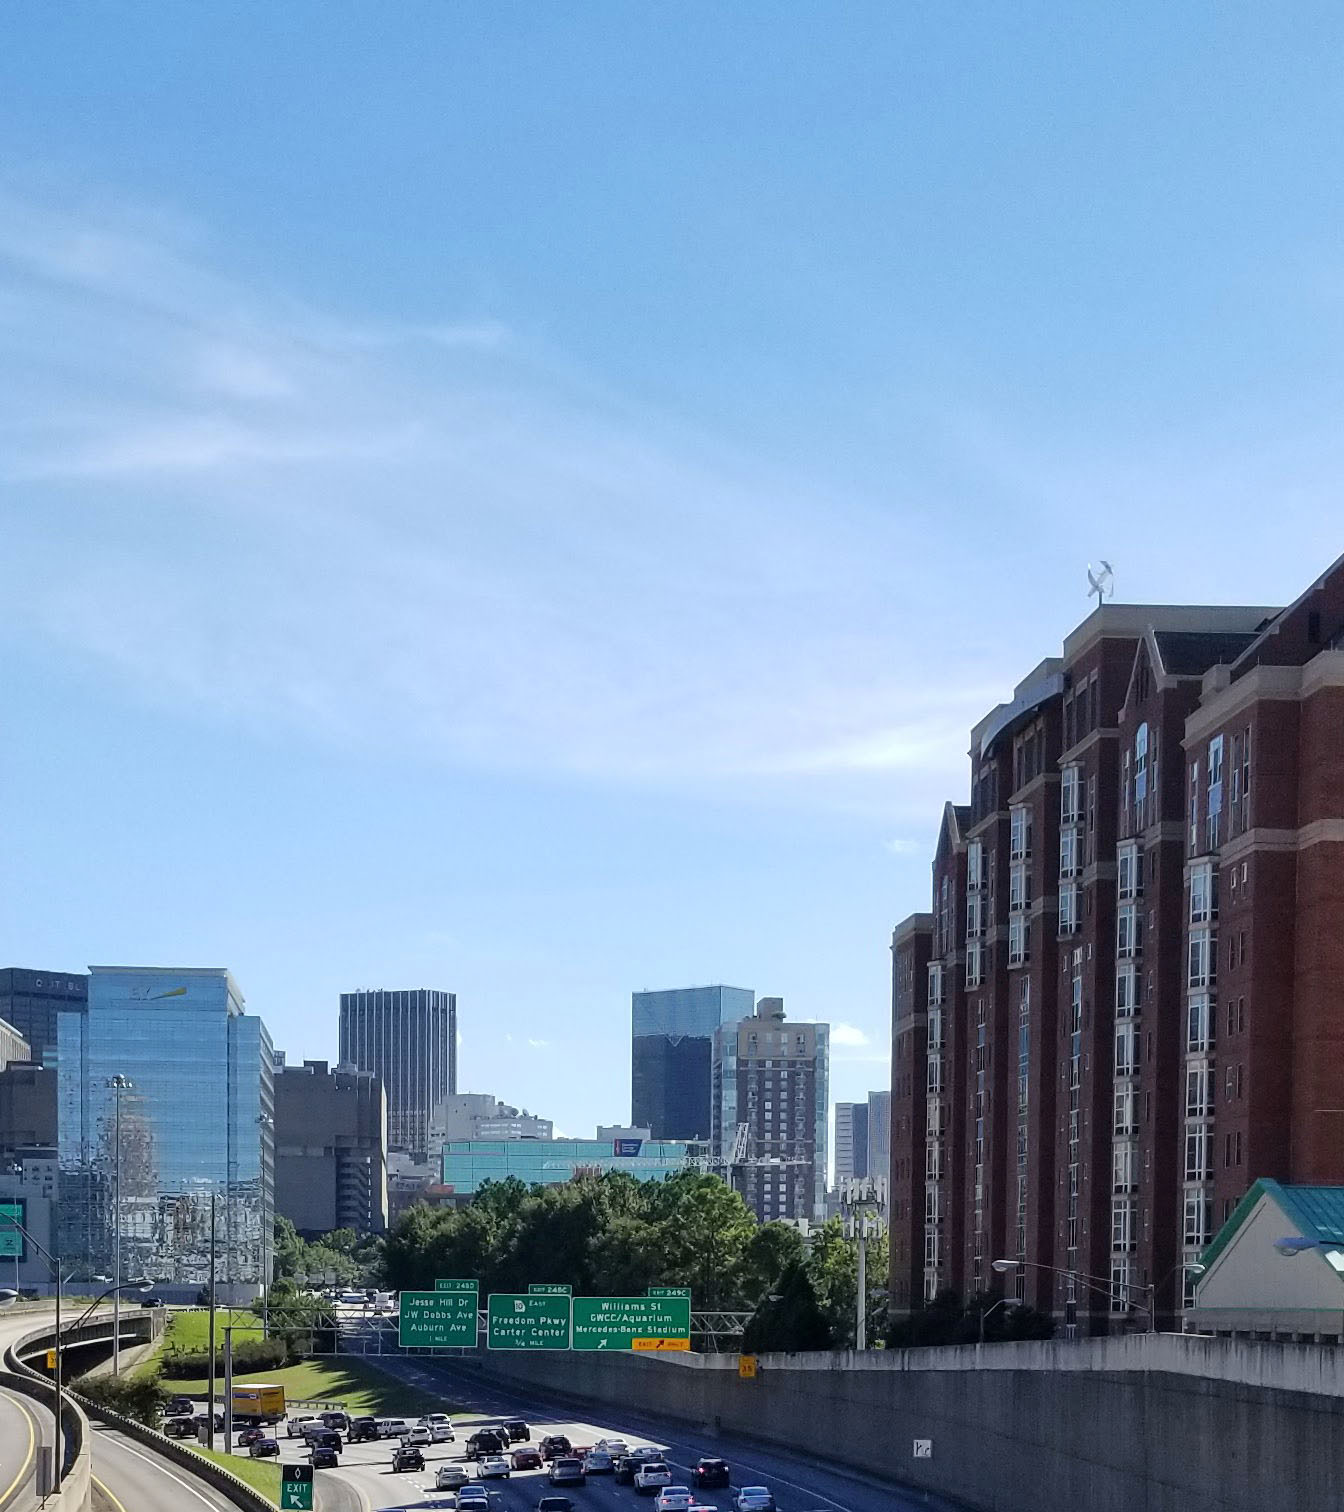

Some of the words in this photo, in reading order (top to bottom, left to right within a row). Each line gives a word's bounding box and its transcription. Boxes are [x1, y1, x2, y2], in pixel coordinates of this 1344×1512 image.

[666, 1289, 686, 1297] 249C
[409, 1297, 434, 1306] Jesse
[439, 1298, 453, 1306] Hill
[458, 1298, 469, 1306] Dr
[601, 1302, 646, 1311] Williams
[650, 1302, 662, 1311] St
[404, 1310, 419, 1319] JW
[423, 1310, 452, 1319] Dobbs
[456, 1311, 474, 1319] Ave
[590, 1313, 673, 1323] GWCC/Aquarium
[492, 1315, 536, 1325] Freedom
[539, 1316, 567, 1327] Pkwy
[410, 1323, 444, 1332] Auburn
[449, 1323, 467, 1332] Ave
[493, 1327, 526, 1336] Carter
[531, 1327, 565, 1337] Center
[575, 1325, 643, 1333] Mercedes-Benz
[647, 1325, 686, 1333] Stadium
[286, 1483, 308, 1493] EXIT
